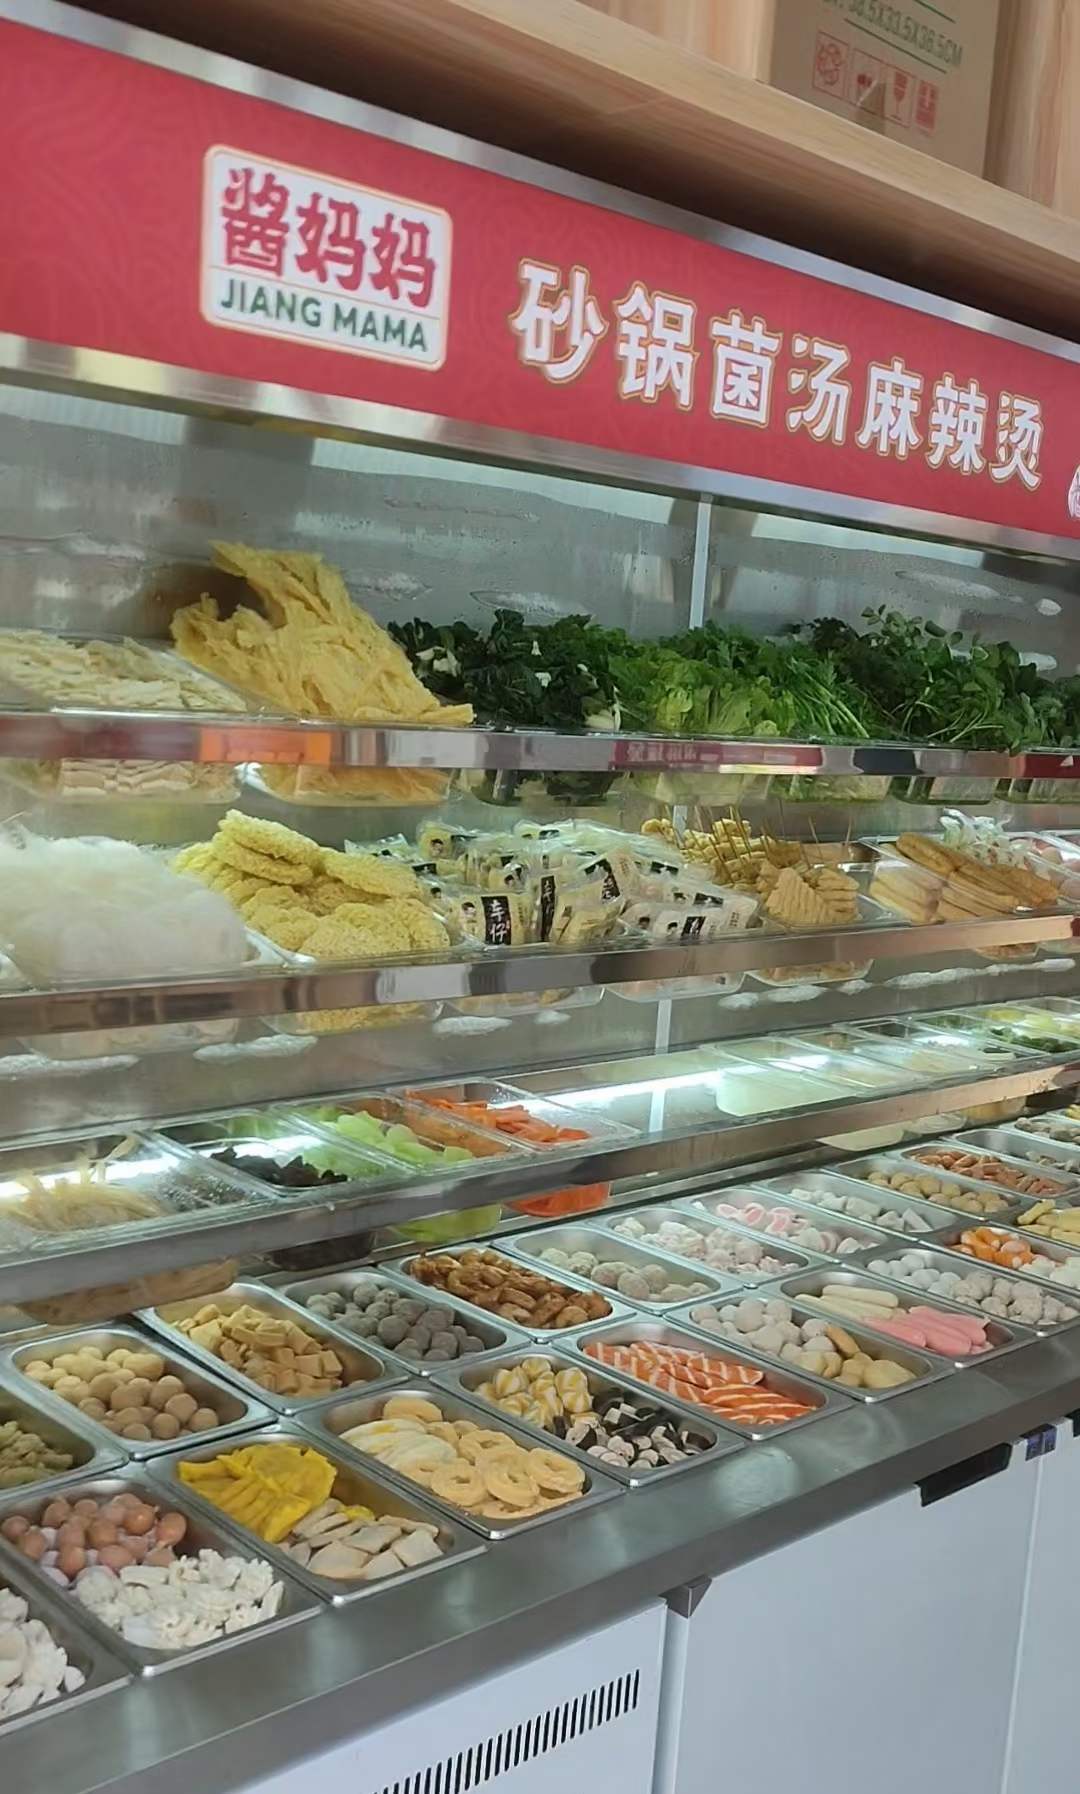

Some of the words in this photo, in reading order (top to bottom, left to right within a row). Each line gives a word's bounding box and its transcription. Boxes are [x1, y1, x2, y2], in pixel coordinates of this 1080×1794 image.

[222, 167, 435, 308] 酱妈妈
[220, 278, 322, 328] JIANG
[333, 303, 428, 353] MAMA
[511, 258, 1043, 490] 砂锅菌汤麻辣烫
